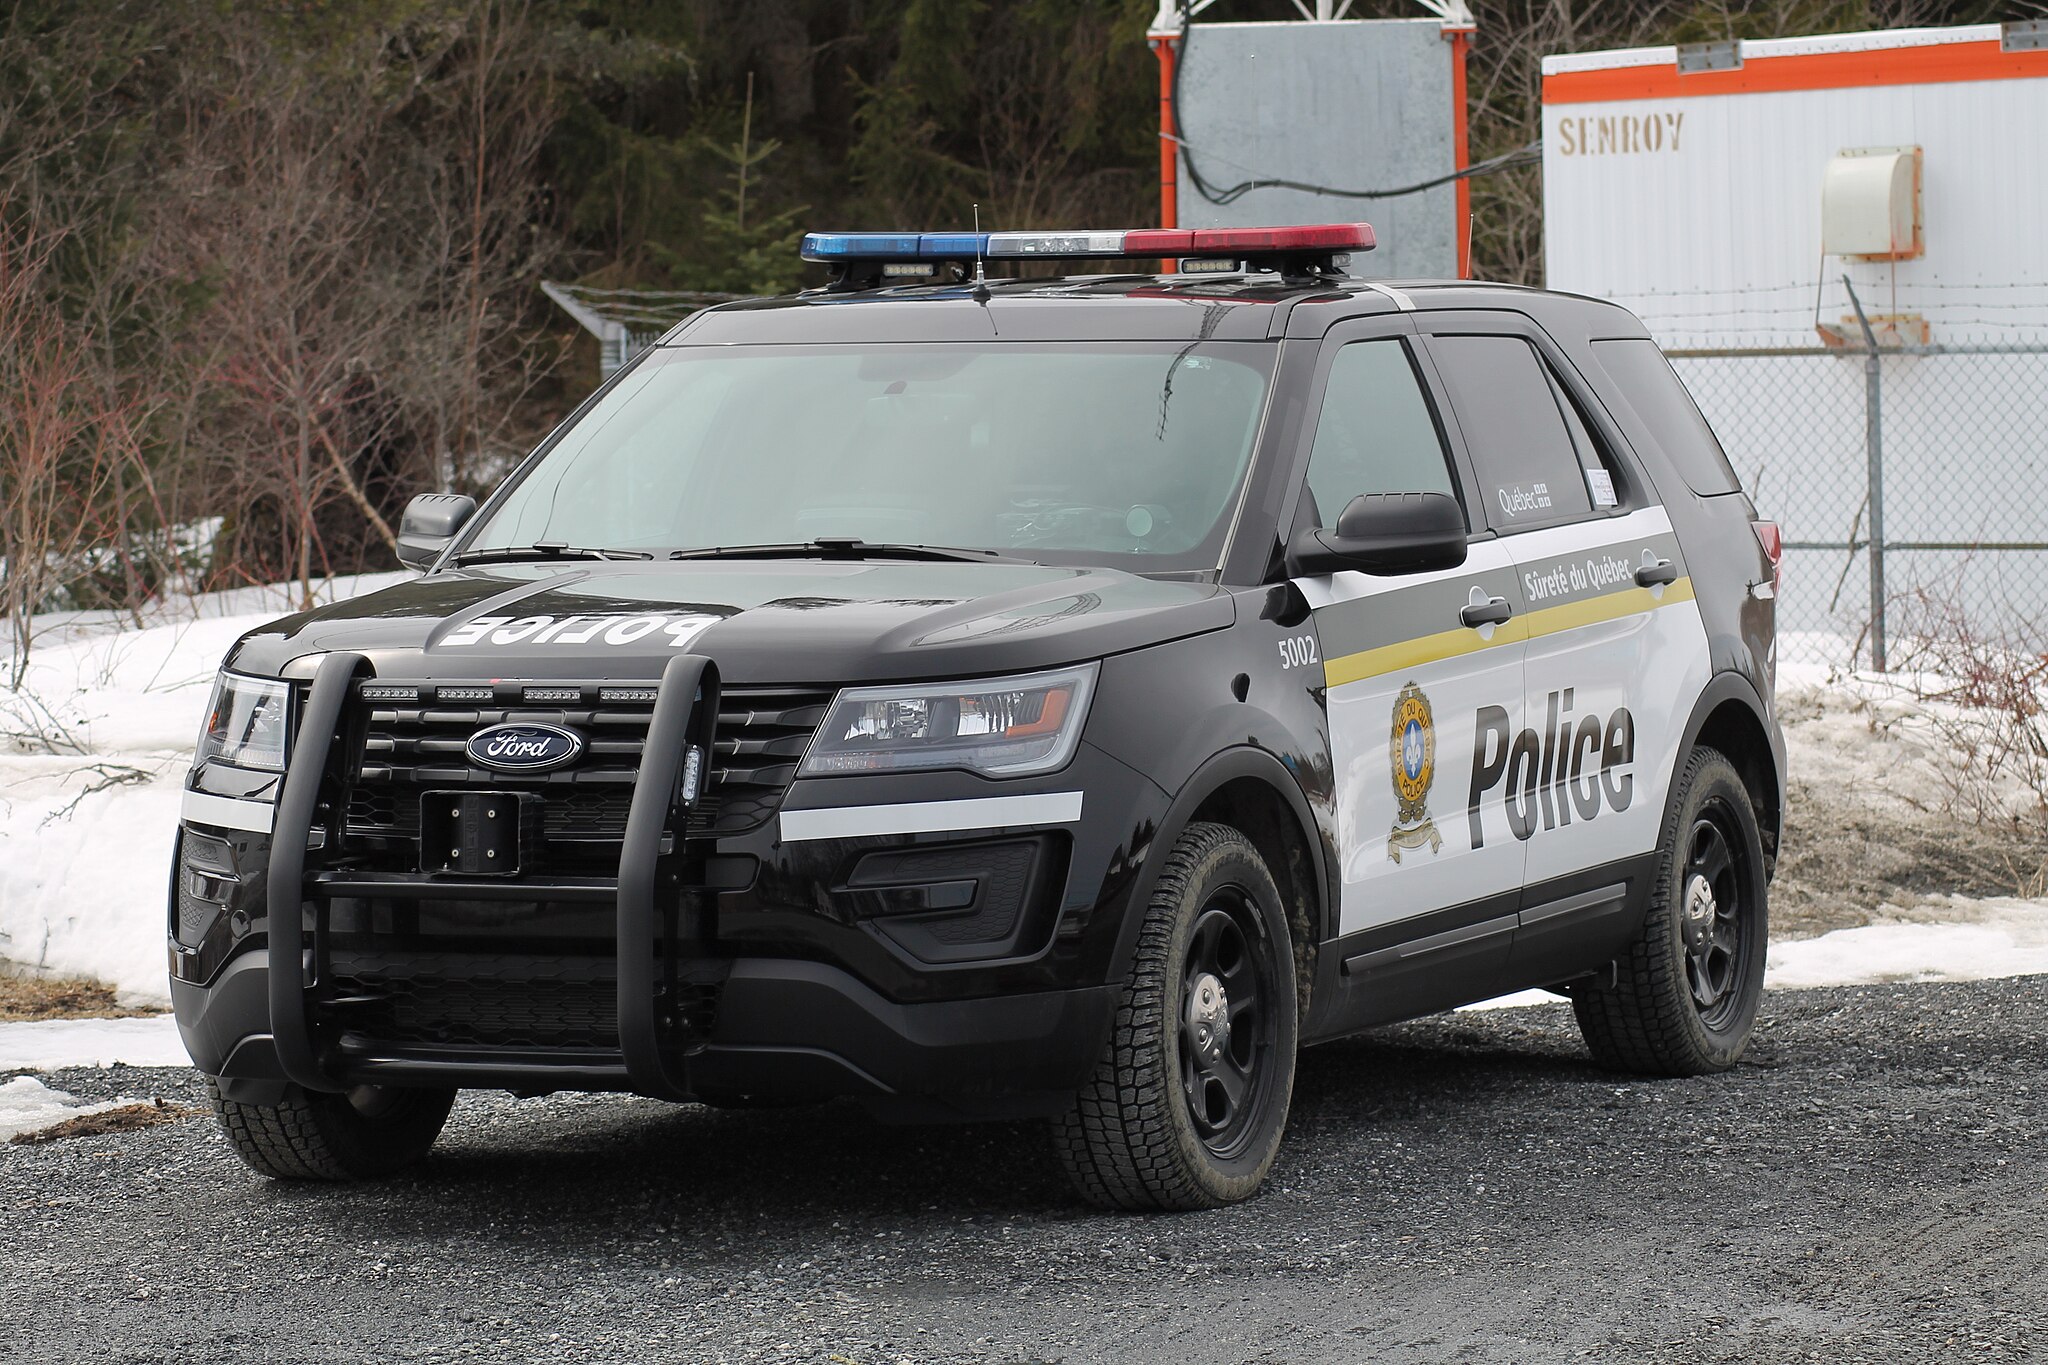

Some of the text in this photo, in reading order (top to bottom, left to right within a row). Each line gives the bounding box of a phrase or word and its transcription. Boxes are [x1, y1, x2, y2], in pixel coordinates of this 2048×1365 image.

[1560, 112, 1684, 156] SENROY
[1498, 486, 1539, 517] Québec
[1524, 555, 1633, 601] Sûreté du Québec
[1278, 635, 1318, 669] 5002
[1406, 701, 1416, 717] DU
[487, 729, 552, 757] Ford
[1467, 686, 1635, 850] Police
[1402, 775, 1425, 798] POLICE
